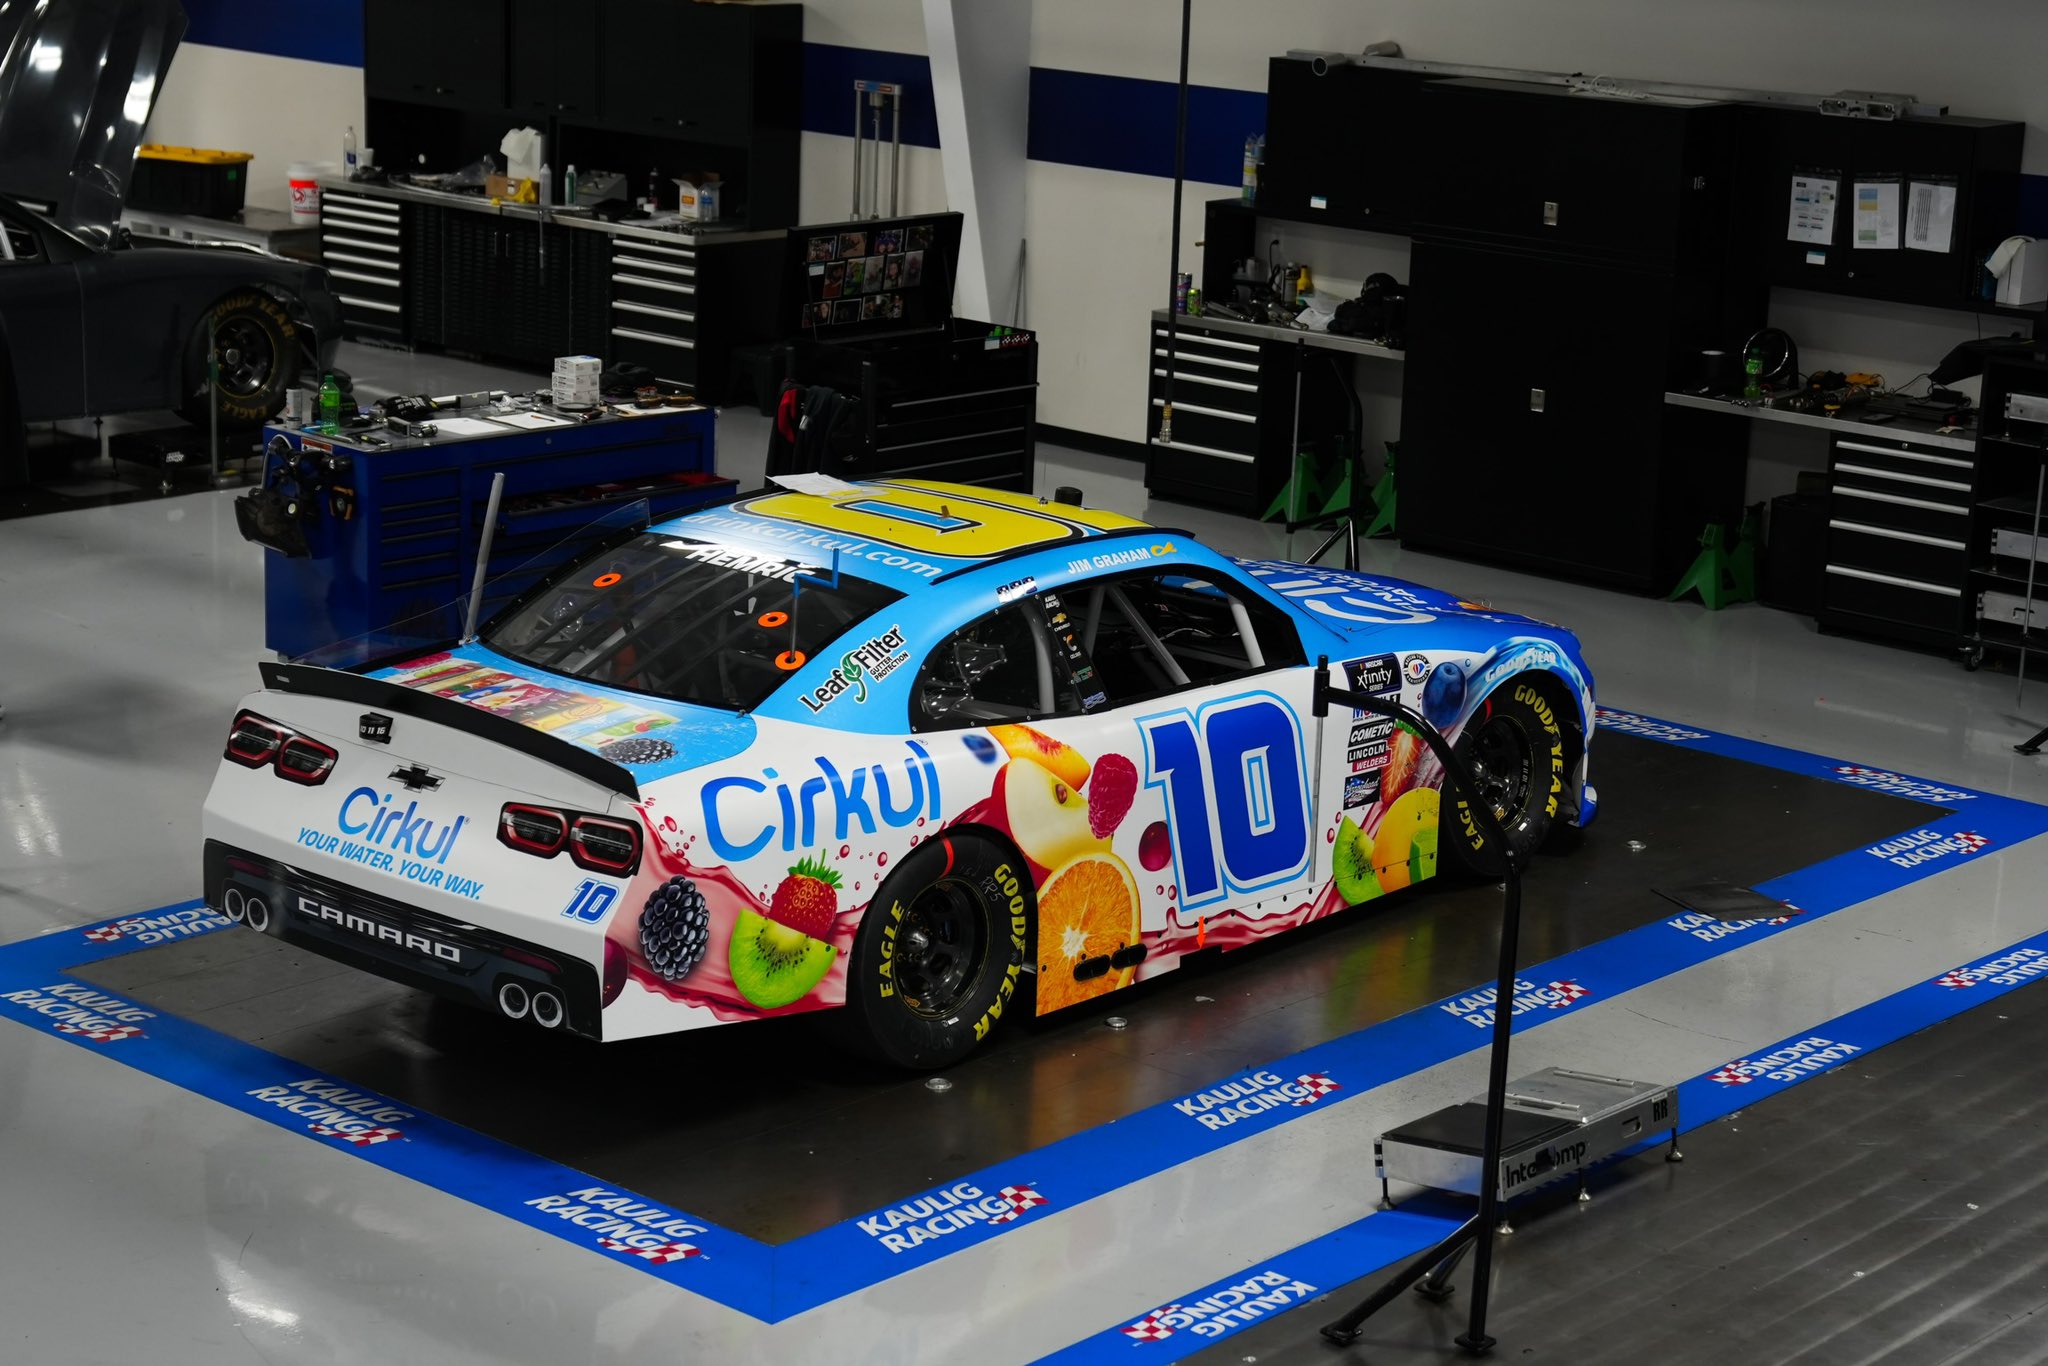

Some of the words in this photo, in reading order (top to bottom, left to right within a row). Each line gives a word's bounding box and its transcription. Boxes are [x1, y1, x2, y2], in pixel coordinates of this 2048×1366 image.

[680, 513, 943, 577] drinkcirkul.com
[1067, 560, 1093, 575] JIM
[1094, 547, 1151, 569] GRAHAM
[800, 669, 850, 712] Leaf
[852, 625, 905, 670] Filter
[869, 656, 893, 676] GUTTER
[874, 651, 909, 682] PROTECTION
[1357, 668, 1392, 689] xfinity
[1364, 659, 1383, 669] NASCAR
[1349, 743, 1385, 761] LINCOLN
[1350, 722, 1394, 743] COMETIC
[1514, 685, 1564, 818] GOODYEAR
[1356, 755, 1388, 770] WELDERS
[1860, 772, 1978, 799] RACING
[700, 740, 942, 862] Cirkul
[1135, 692, 1314, 913] 10
[1837, 776, 1955, 802] KAULIG
[338, 787, 466, 865] Cirkul
[1865, 829, 1942, 859] KAULIG
[298, 827, 340, 855] YOUR
[339, 837, 394, 873] WATER.
[399, 858, 445, 888] YOUR
[444, 873, 485, 900] WAY.
[1889, 836, 1968, 869] RACING
[562, 877, 619, 924] 10
[135, 915, 233, 944] AULIG
[298, 896, 460, 964] CAMARO
[879, 899, 906, 998] EAGLE
[973, 863, 1027, 1042] GOODYEAR
[1958, 948, 2047, 981] RACING
[0, 990, 122, 1036] RACING
[41, 983, 158, 1022] KAULIG
[1742, 1035, 1833, 1077] RACING
[1766, 1041, 1862, 1082] KAULIG
[246, 1086, 381, 1138] RACING
[286, 1078, 416, 1123] KAULIG
[1172, 1070, 1283, 1117] KAULIG
[1195, 1082, 1310, 1130] RACING
[1653, 1098, 1668, 1122] RR
[523, 1195, 671, 1250] RACING
[566, 1187, 709, 1238] KAULIG
[856, 1182, 984, 1237] KAULIG
[878, 1195, 1010, 1254] RACING
[1159, 1270, 1291, 1330] RACING
[1190, 1280, 1319, 1337] KAULIG
